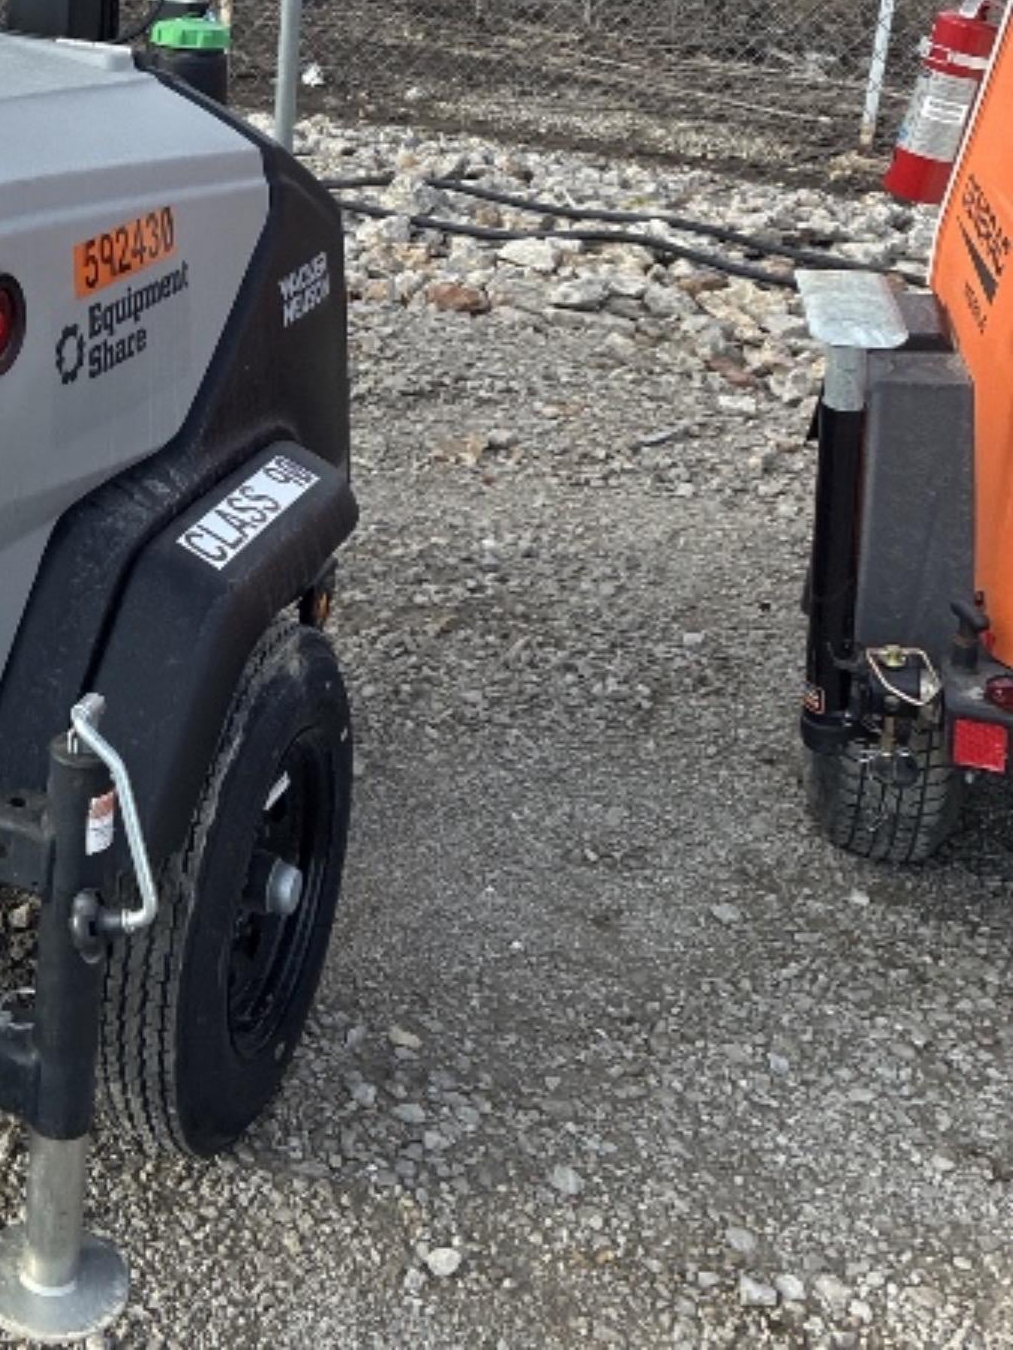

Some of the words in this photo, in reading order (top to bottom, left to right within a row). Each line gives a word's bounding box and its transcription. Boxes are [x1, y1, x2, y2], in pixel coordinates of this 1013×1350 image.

[83, 206, 175, 290] 592430
[88, 259, 188, 340] Equipment
[88, 327, 147, 380] Share
[184, 485, 280, 562] CLASS
